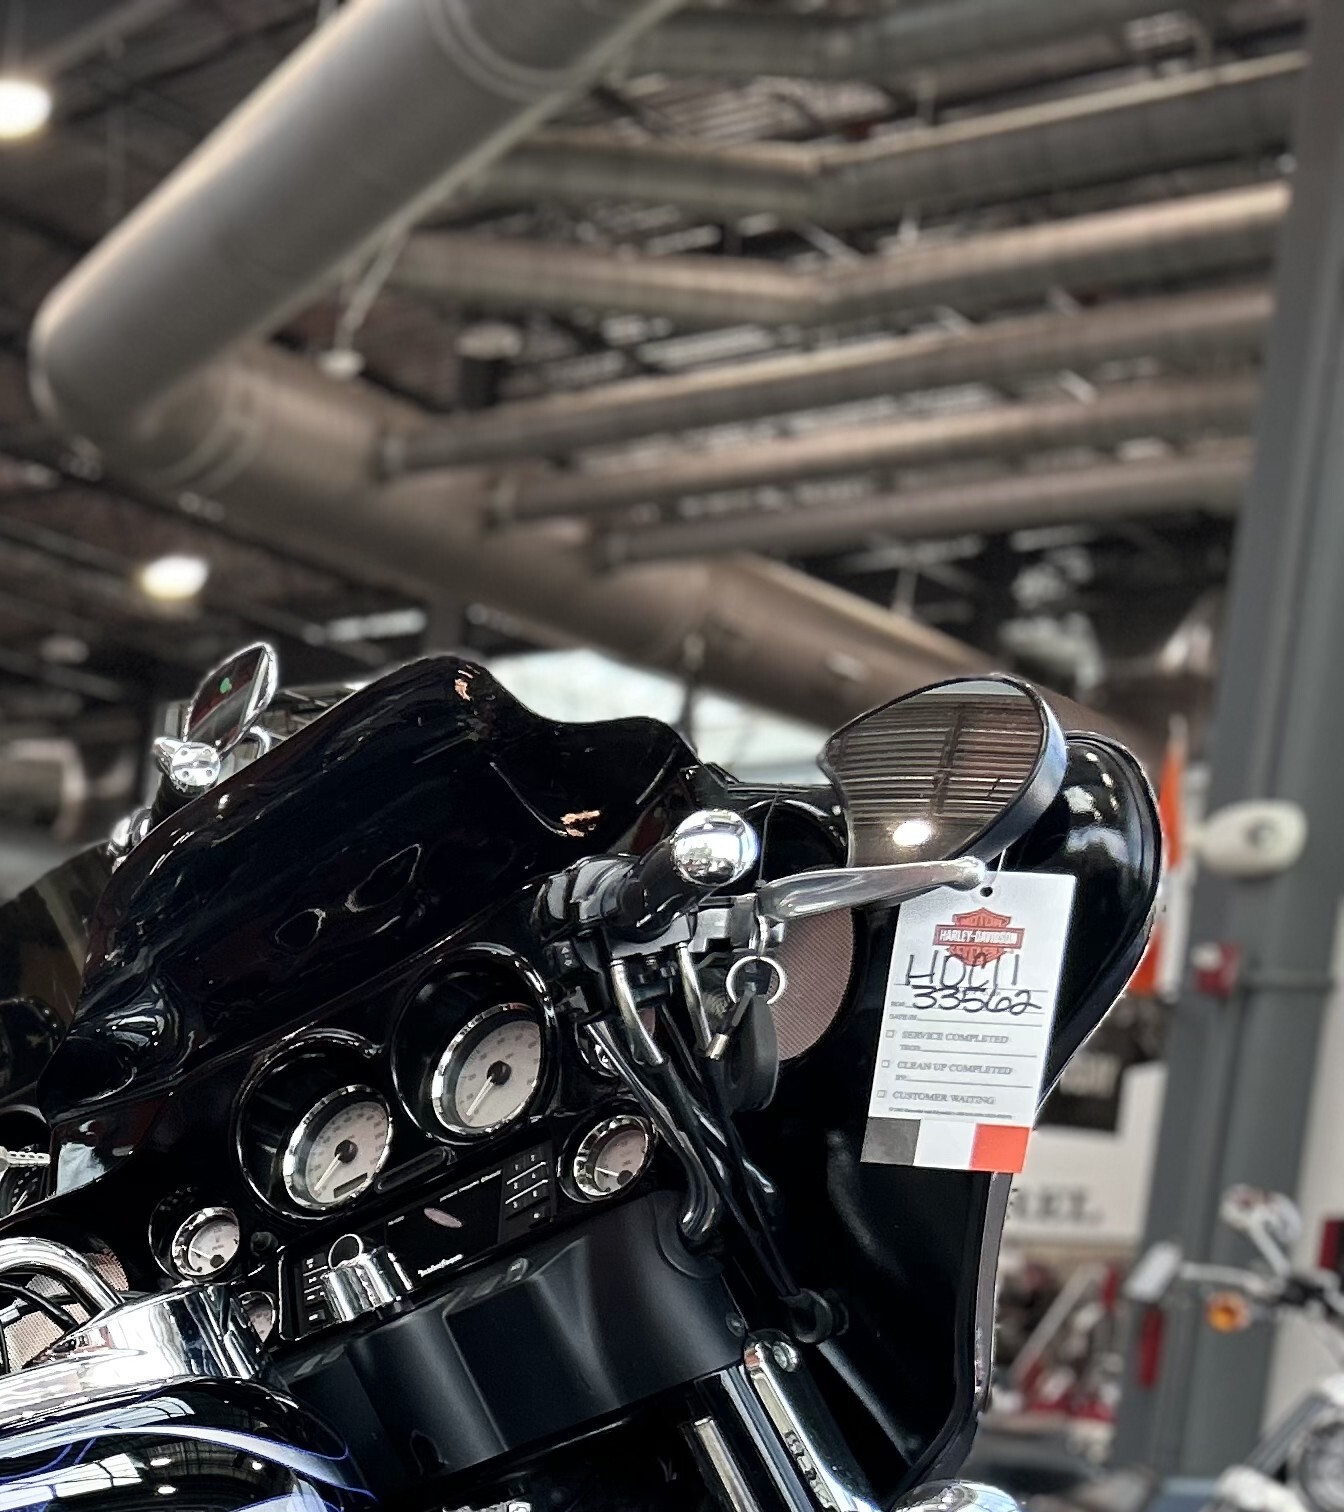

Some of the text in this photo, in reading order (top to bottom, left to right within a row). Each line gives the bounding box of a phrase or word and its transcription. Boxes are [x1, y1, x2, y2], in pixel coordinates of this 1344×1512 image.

[939, 928, 1018, 945] HARLEY-DAVIDSON
[910, 984, 1043, 1016] 33562
[902, 1030, 1009, 1044] SERVICE COMPLETED
[897, 1060, 1013, 1075] CLEAN UP COMPLETED
[892, 1090, 996, 1105] CUSTOMER WAITING
